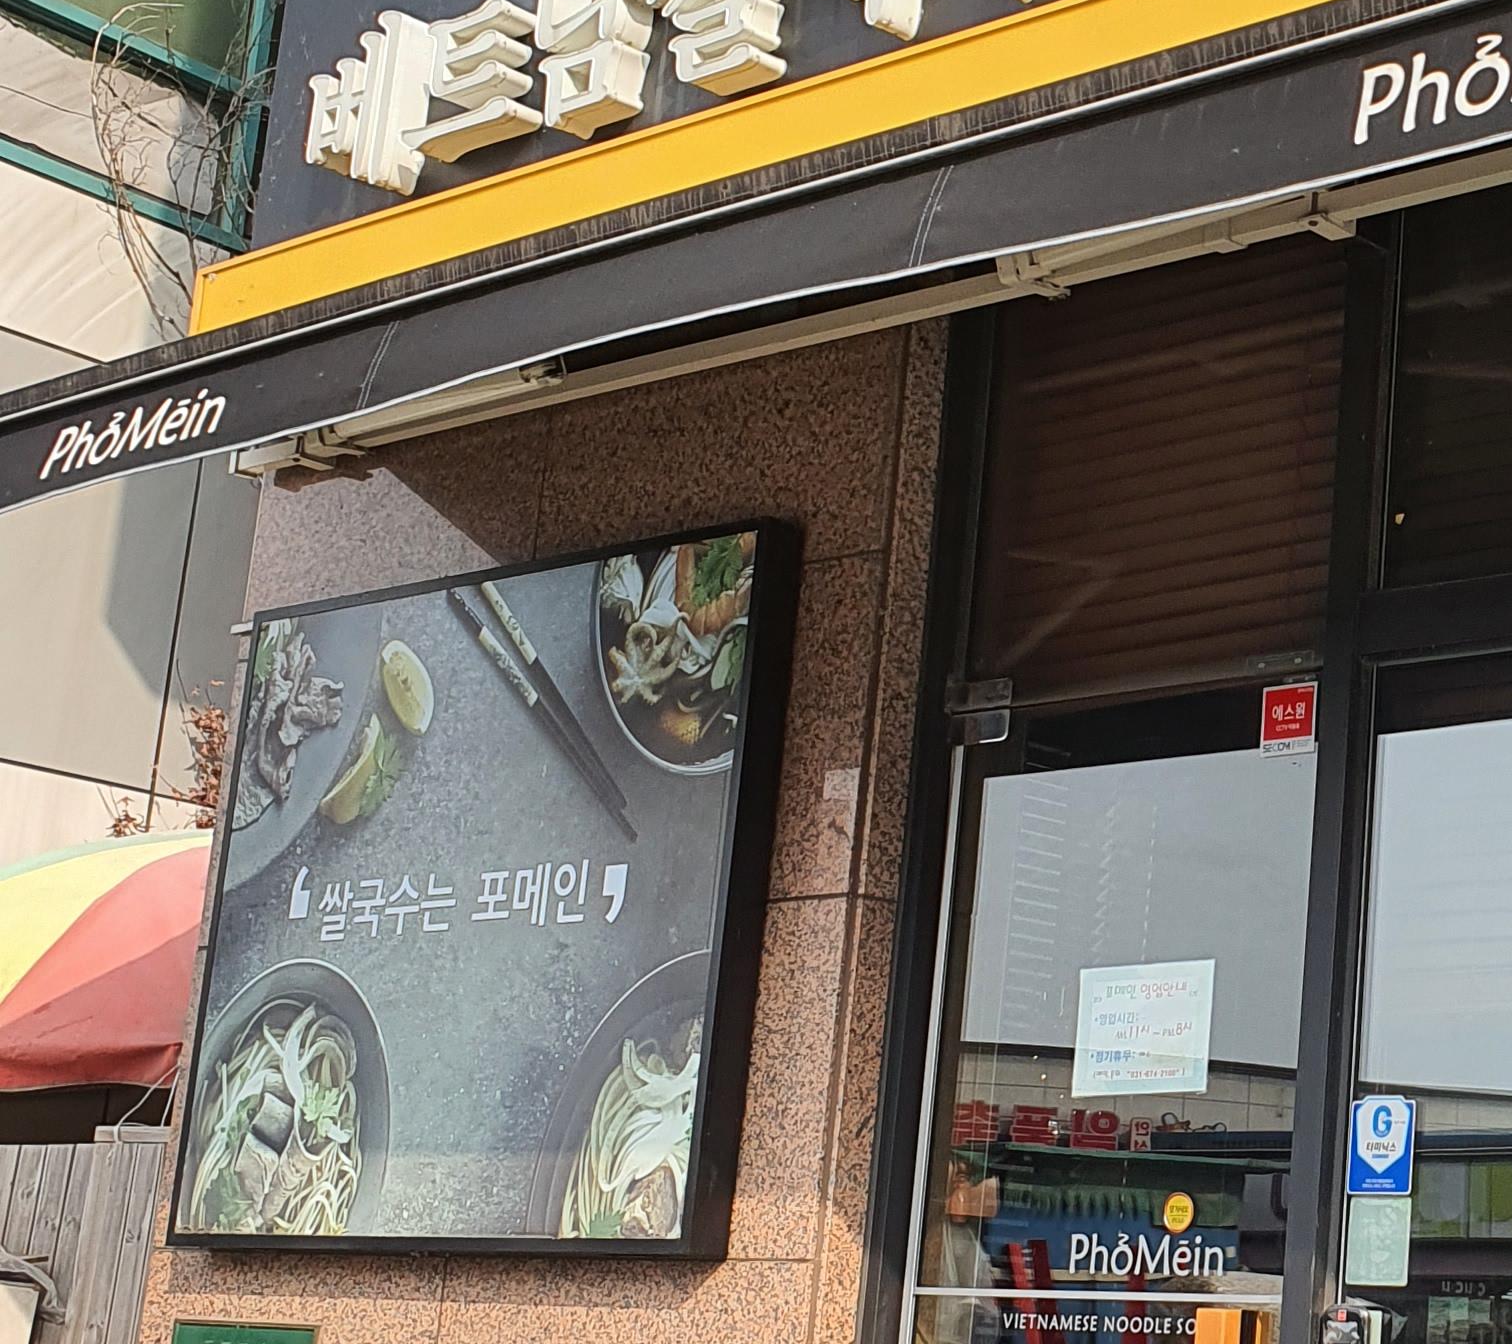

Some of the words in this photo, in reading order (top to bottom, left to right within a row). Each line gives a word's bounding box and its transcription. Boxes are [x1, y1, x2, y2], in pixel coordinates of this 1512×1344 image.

[1272, 701, 1306, 721] 에스원
[318, 873, 457, 942] 쌀국수는
[471, 859, 590, 927] 포메인
[1003, 1312, 1098, 1332] VIETNAMESE
[1103, 1316, 1172, 1335] NOODLE
